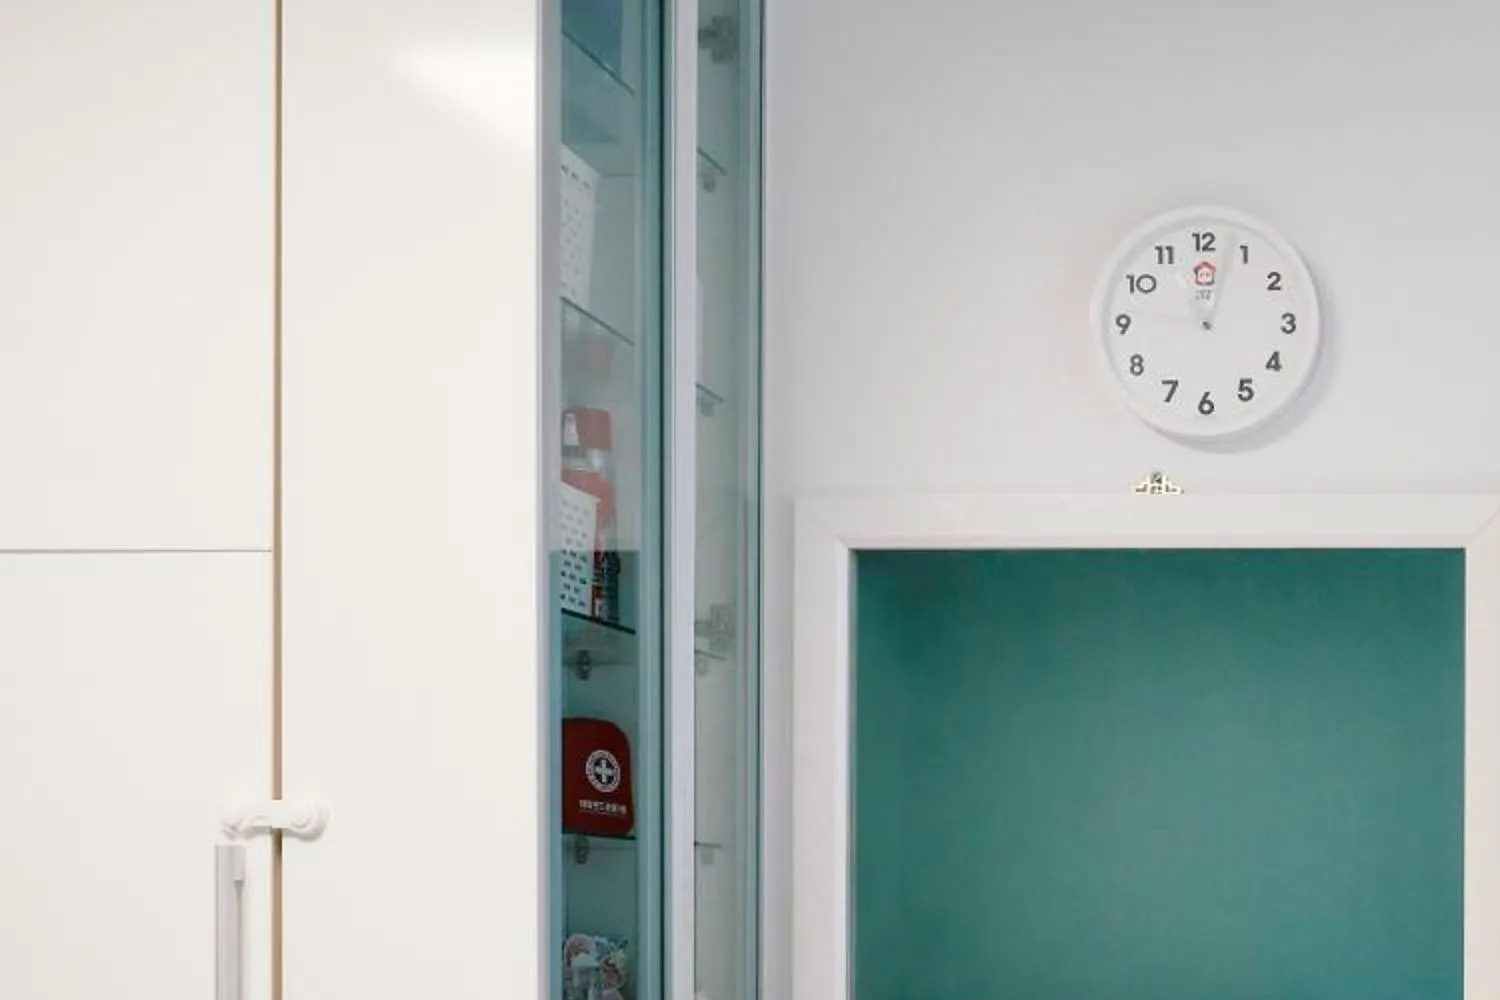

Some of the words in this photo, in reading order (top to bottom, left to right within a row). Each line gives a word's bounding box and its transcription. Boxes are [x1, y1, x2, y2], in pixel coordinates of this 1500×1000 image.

[1191, 231, 1217, 252] 12
[1154, 245, 1175, 265] 11
[1239, 244, 1249, 265] 1
[1125, 273, 1157, 295] 10
[1266, 271, 1282, 291] 2
[1115, 313, 1132, 335] 9
[1280, 312, 1297, 335] 3
[1129, 353, 1145, 376] 8
[1265, 350, 1283, 372] 4
[1161, 379, 1179, 403] 7
[1237, 378, 1255, 402] 5
[1197, 391, 1215, 415] 6
